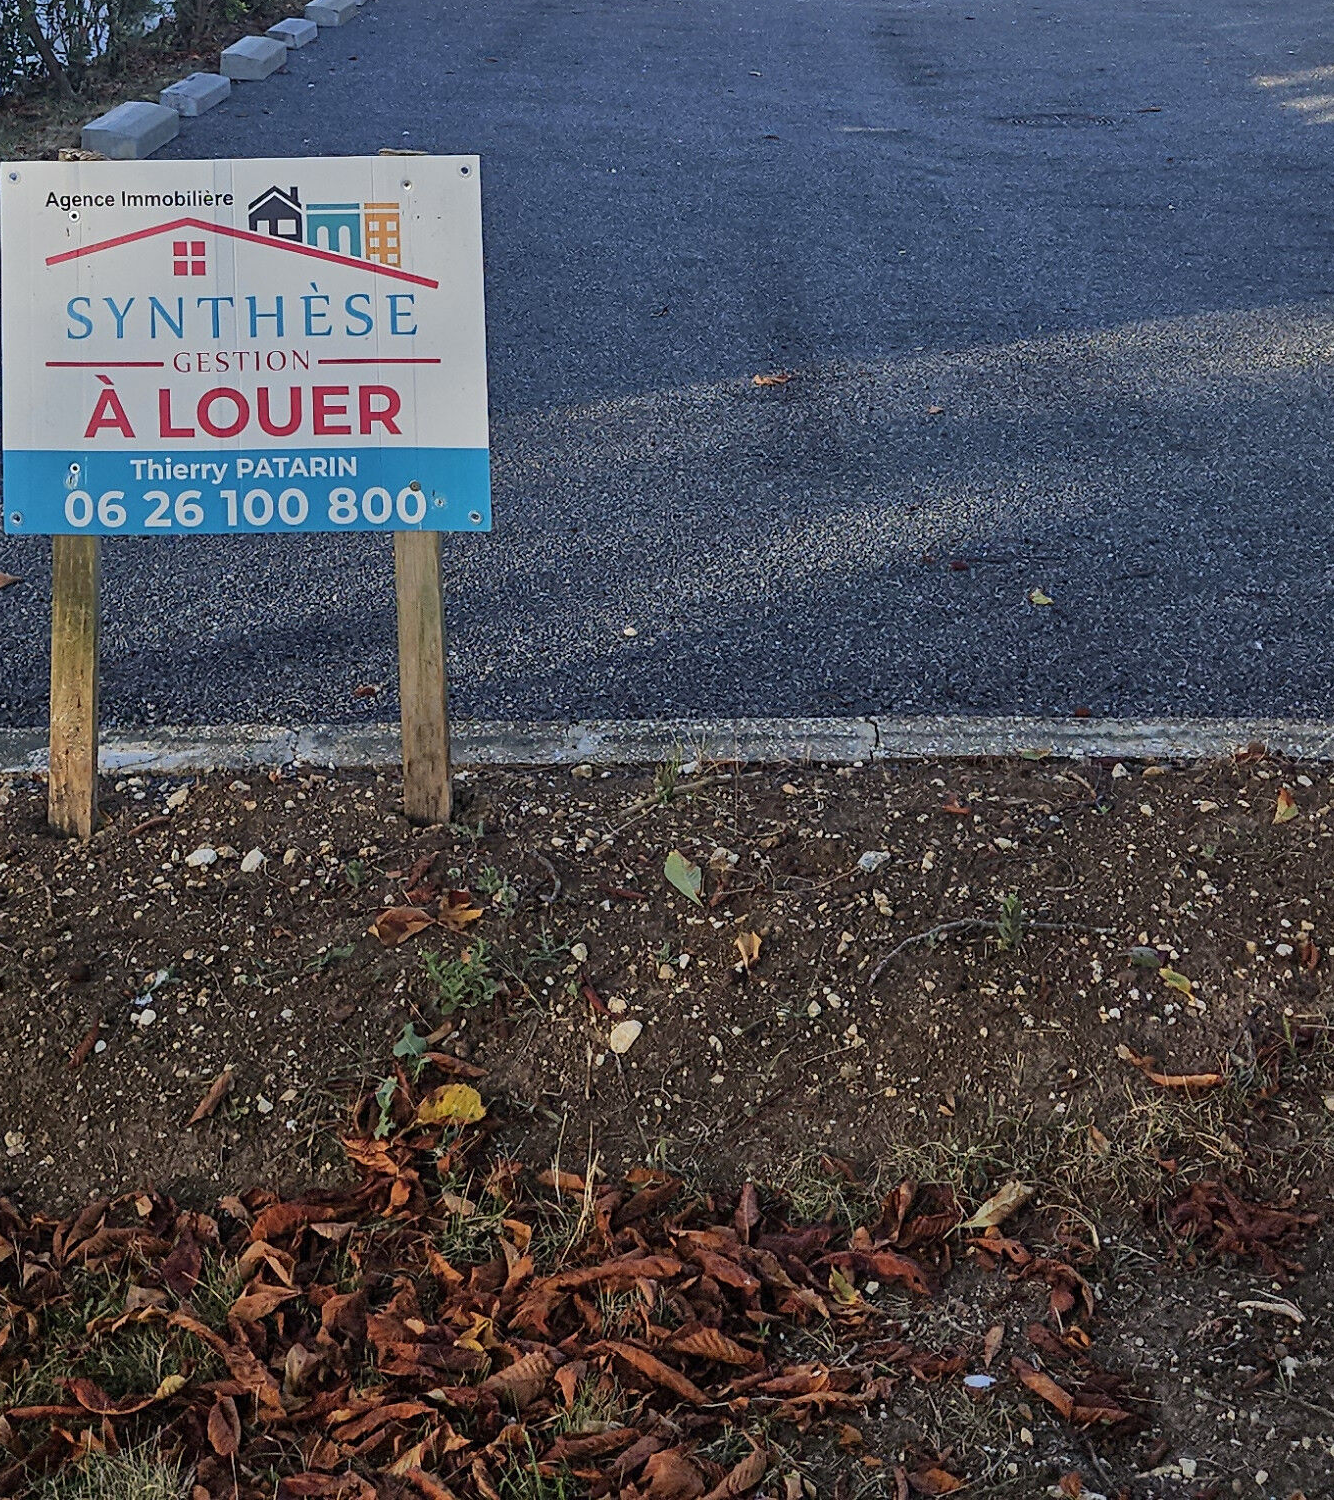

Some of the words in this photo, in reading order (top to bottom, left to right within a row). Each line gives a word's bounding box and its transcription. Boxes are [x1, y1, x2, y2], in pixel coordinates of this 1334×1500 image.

[45, 191, 115, 211] Agence
[121, 188, 234, 207] Immobilière
[66, 282, 418, 339] SYNTHÈSE
[173, 350, 310, 372] GESTION
[84, 375, 135, 438] À
[159, 385, 402, 438] LOUER
[130, 457, 228, 484] Thierry
[236, 457, 357, 480] PATARIN
[64, 490, 127, 528] 06
[143, 490, 204, 527] 26
[220, 490, 309, 526] 100
[328, 487, 427, 525] 800
